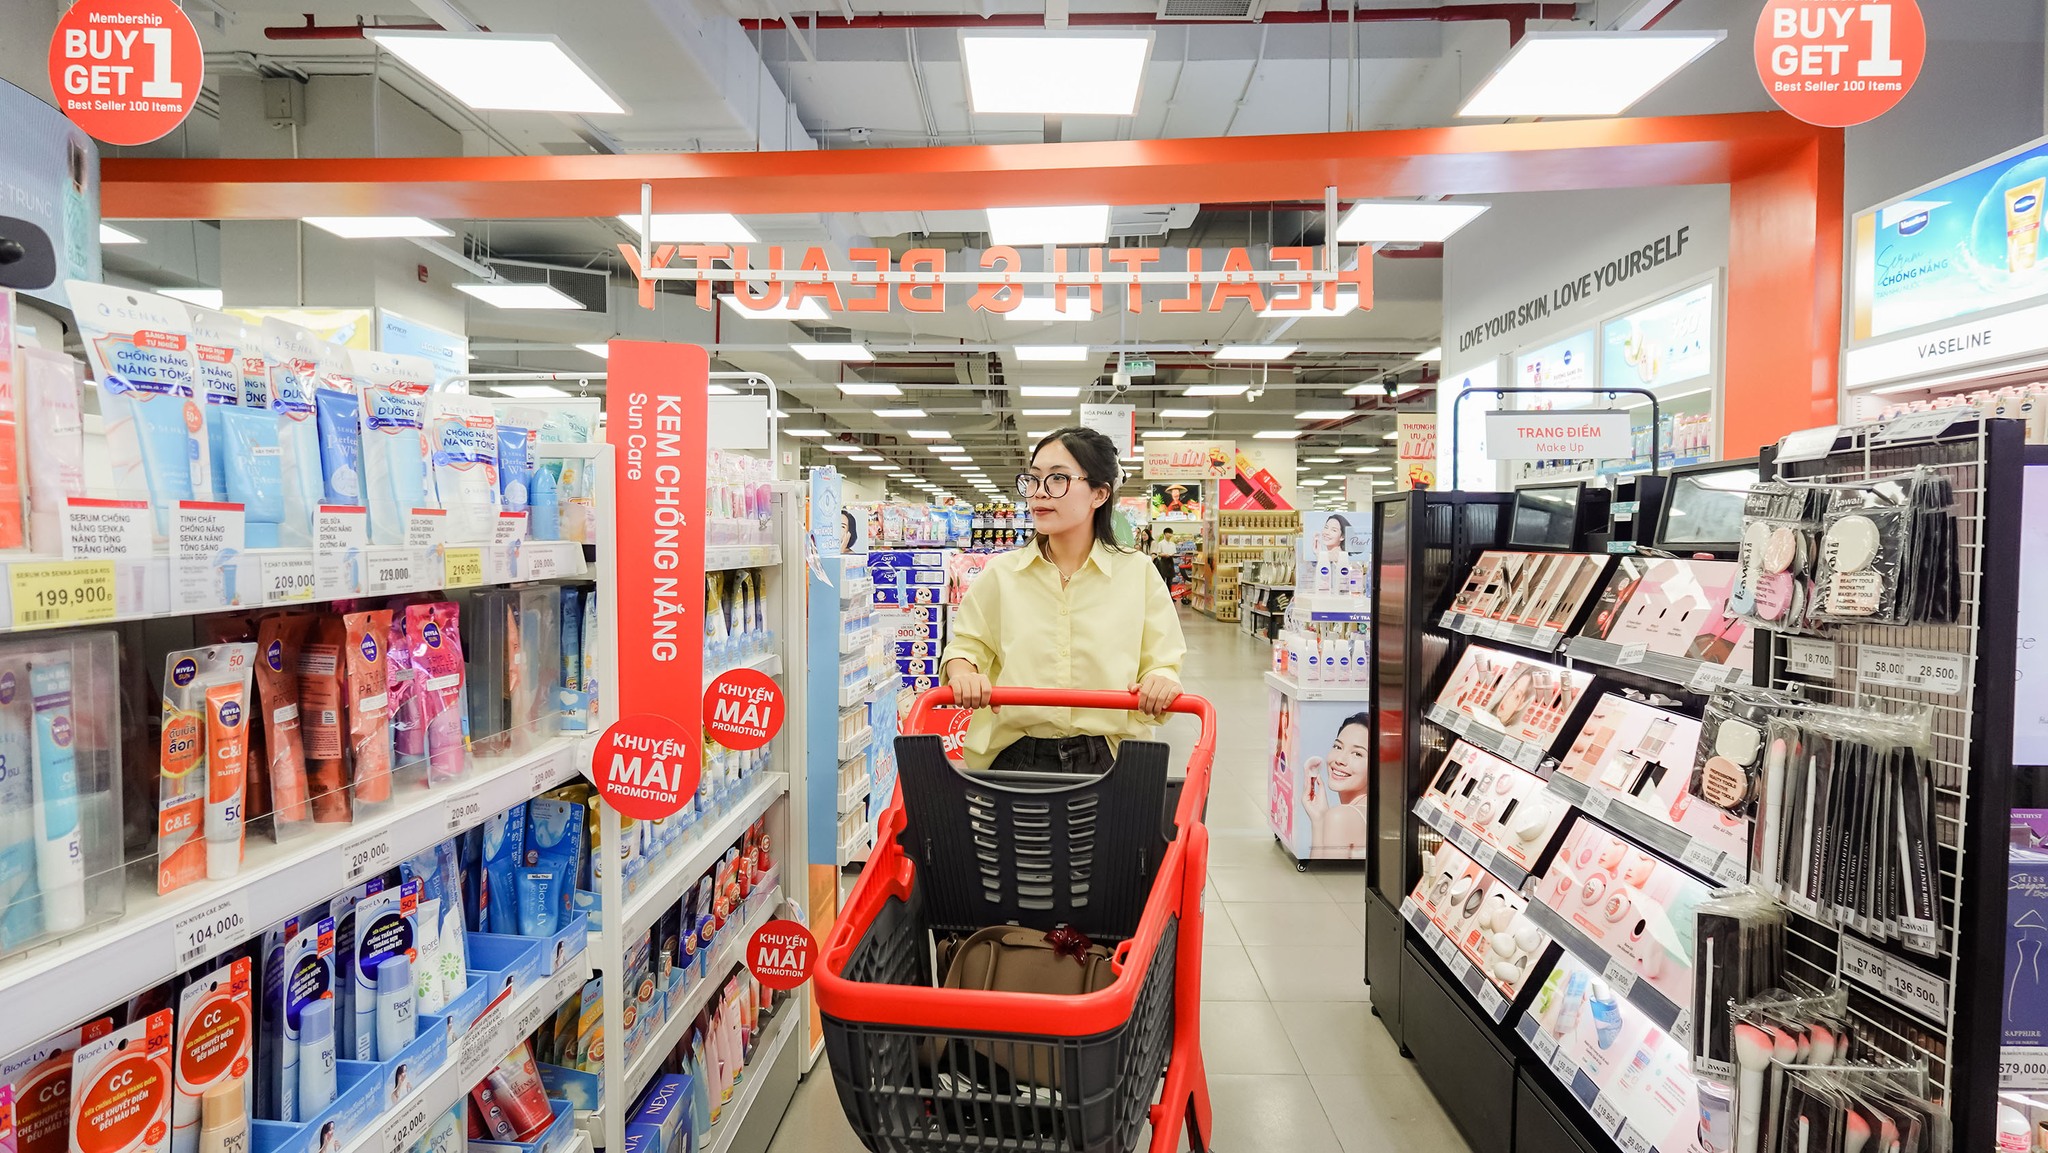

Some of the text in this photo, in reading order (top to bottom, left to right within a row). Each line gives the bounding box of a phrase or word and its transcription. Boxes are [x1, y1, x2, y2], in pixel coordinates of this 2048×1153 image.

[89, 12, 163, 27] Membership
[1773, 7, 1856, 39] BUY
[65, 30, 140, 60] BUY
[1857, 4, 1902, 77] 1
[141, 28, 183, 99] 1
[1771, 44, 1849, 76] GET
[64, 66, 134, 97] GET
[1775, 80, 1902, 92] Best Seller 100 Items
[67, 100, 183, 113] Best Seller 100 Items
[1459, 326, 1483, 352] LOVE
[1484, 309, 1516, 341] YOUR
[1553, 273, 1590, 310] LOVE
[1593, 226, 1689, 292] YOURSELF
[1918, 330, 1992, 359] VASELINE
[628, 392, 648, 481] Sun Care
[1517, 427, 1563, 438] TRANG
[1536, 442, 1584, 453] Make Up
[70, 514, 100, 522] SERUM
[651, 395, 686, 662] KEM CHỐNG NẮNG
[175, 666, 195, 675] NIVEA
[718, 681, 774, 703] KHUYẾN
[222, 707, 240, 716] NIVEA
[713, 697, 771, 729] MÃI
[712, 721, 766, 738] PROMOTION
[612, 732, 686, 758] KHUYẾN
[608, 752, 683, 792] MÃI
[607, 783, 677, 804] PROMOTION
[165, 813, 191, 833] C&E
[759, 933, 808, 948] KHUYẾN
[757, 945, 806, 970] MÃI
[756, 967, 804, 978] PROMOTION
[204, 1009, 221, 1028] CC
[148, 1033, 168, 1050] 50+
[40, 1080, 66, 1102] CC
[109, 1069, 133, 1092] CC
